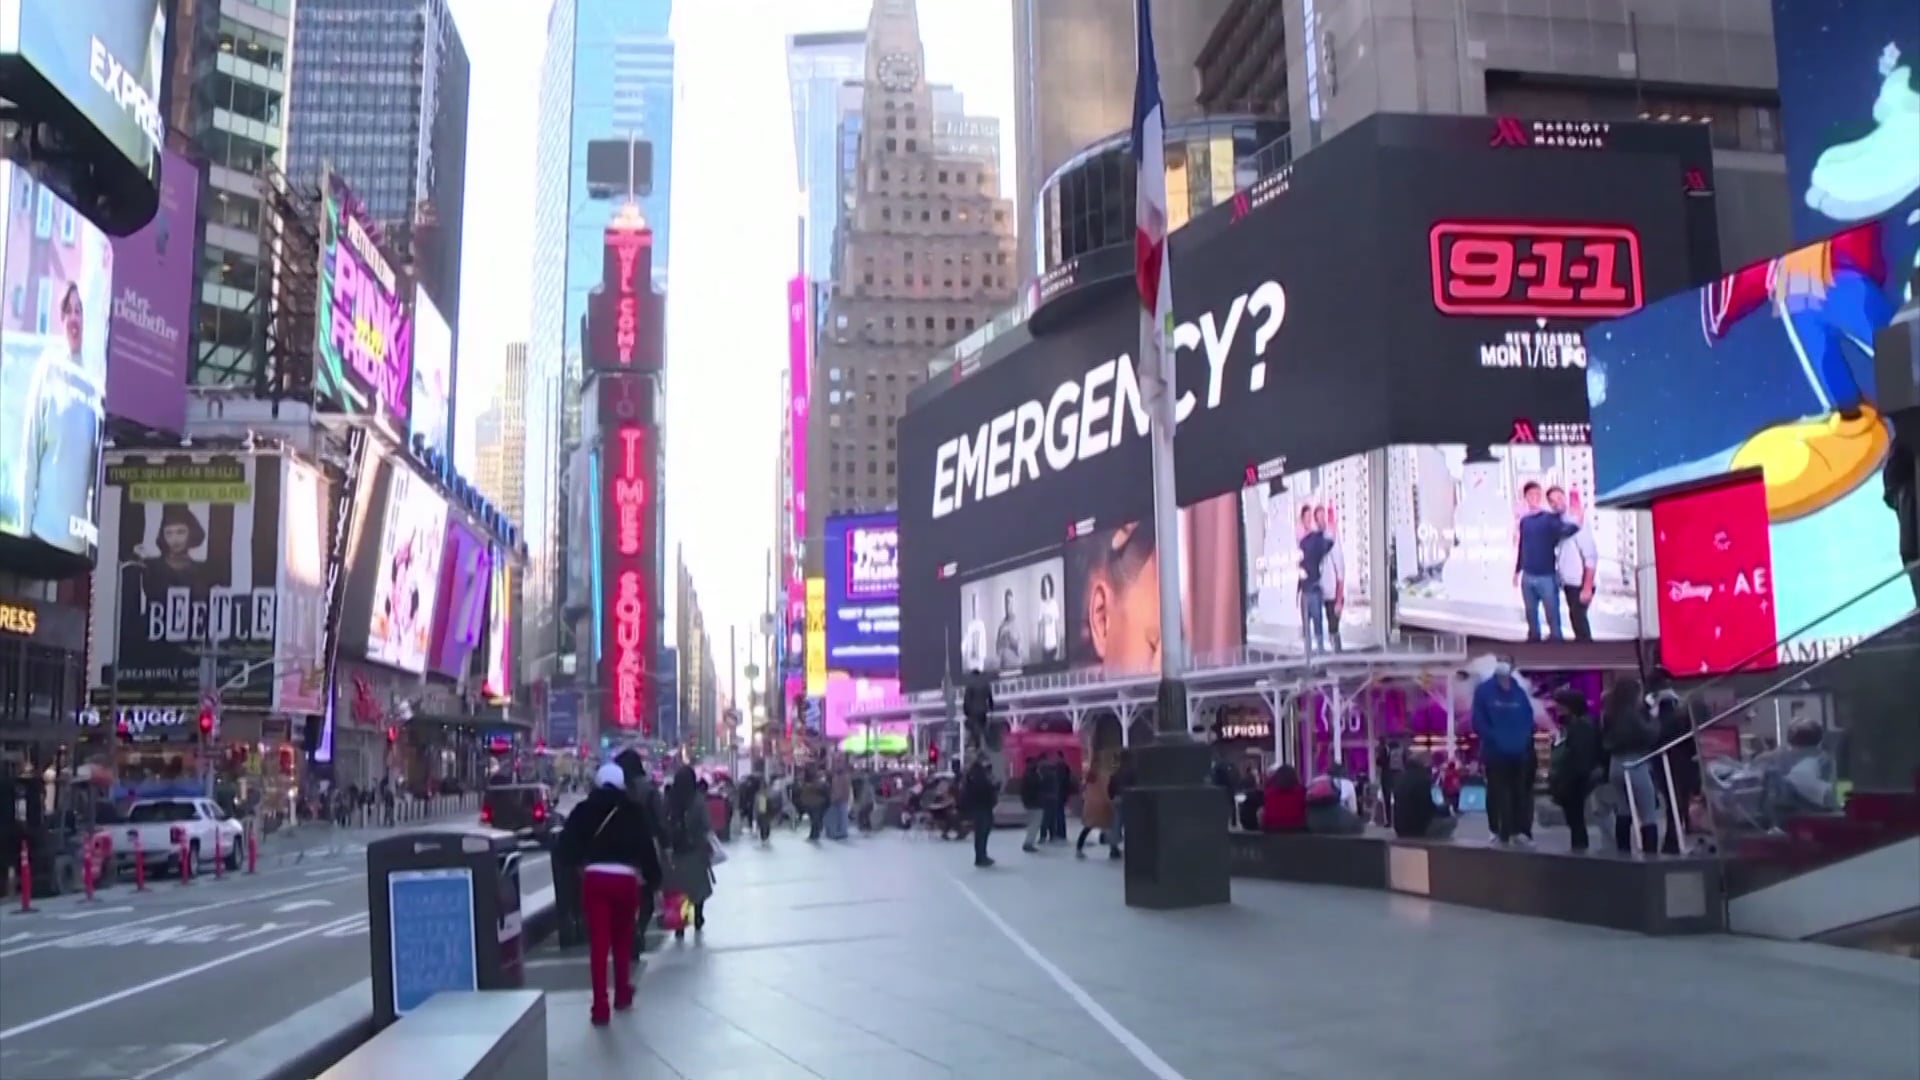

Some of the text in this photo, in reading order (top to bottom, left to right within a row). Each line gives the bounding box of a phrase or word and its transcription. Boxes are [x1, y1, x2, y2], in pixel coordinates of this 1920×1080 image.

[1481, 344, 1522, 367] MON
[1561, 345, 1587, 368] FO
[932, 280, 1286, 519] EMERGENCY?
[615, 428, 644, 555] TIMES
[332, 496, 350, 558] MAC
[149, 588, 276, 641] BEETLE
[615, 571, 642, 725] SQUARE
[1780, 634, 1860, 661] AMER
[1221, 724, 1270, 738] SEPHORA
